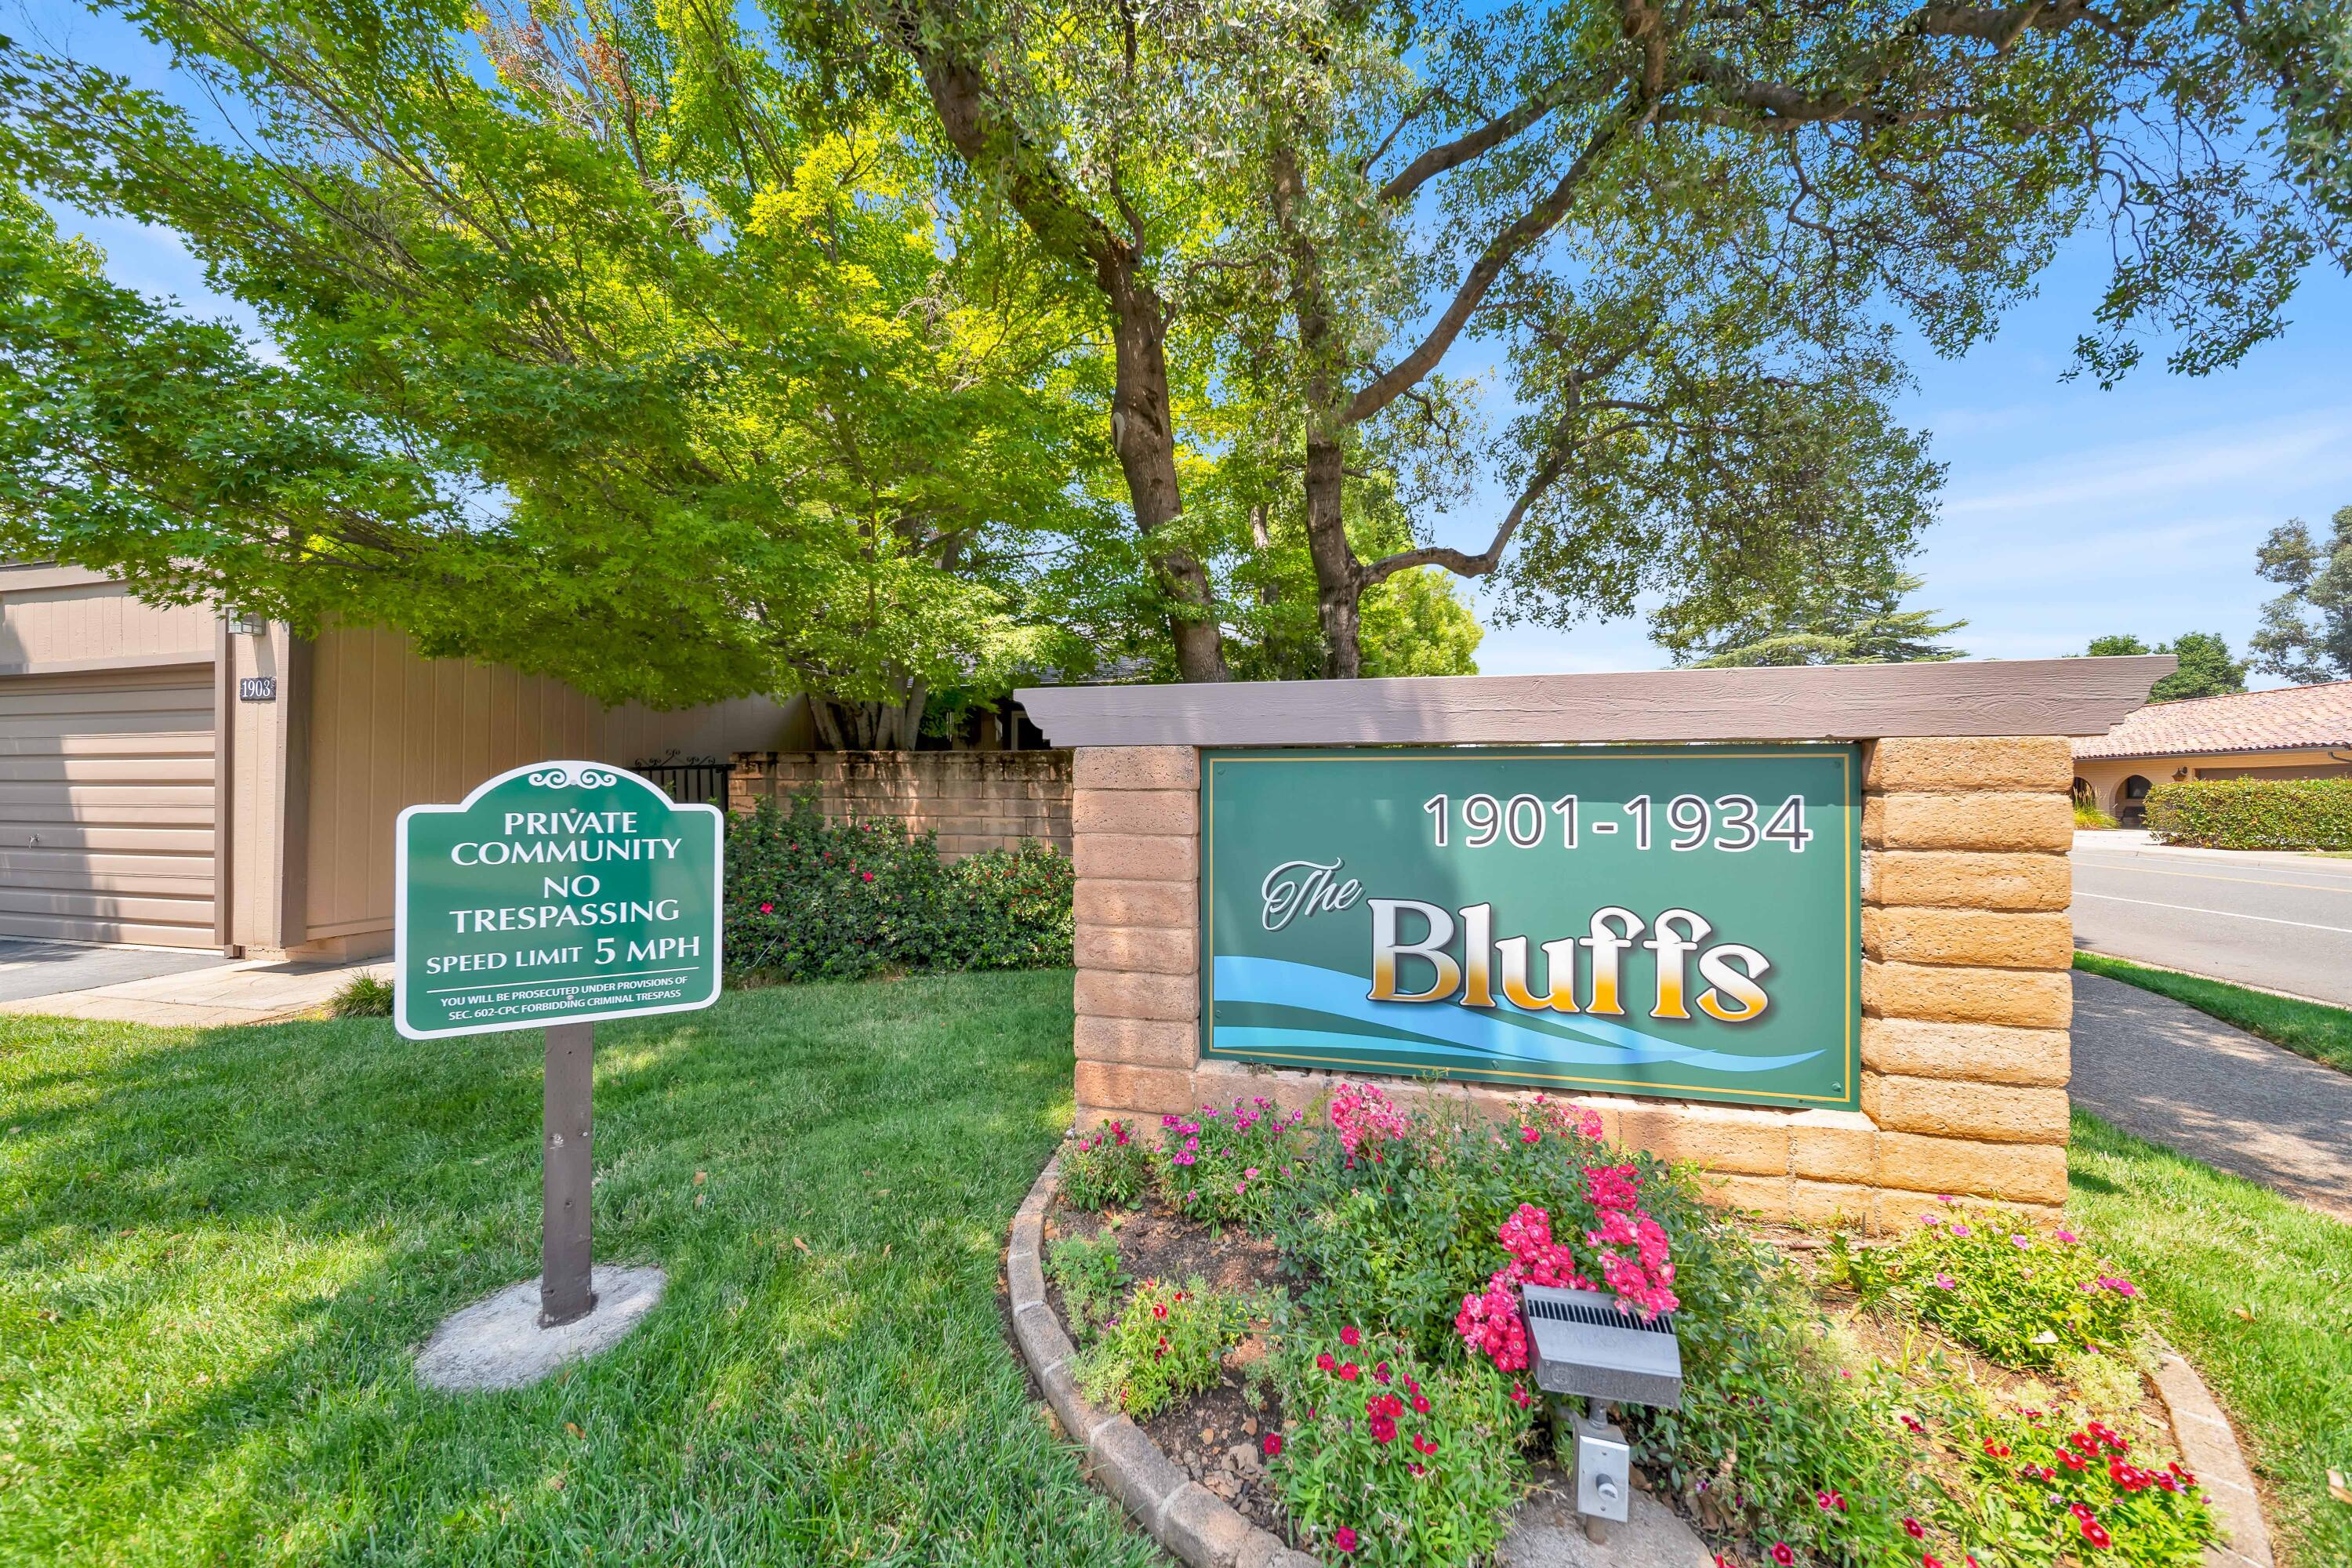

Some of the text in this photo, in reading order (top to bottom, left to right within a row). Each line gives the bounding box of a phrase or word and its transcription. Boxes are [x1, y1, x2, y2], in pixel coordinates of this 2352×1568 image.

[241, 680, 270, 697] 1903
[504, 811, 637, 836] PRIVATE
[1424, 793, 1813, 852] 1901-1934
[451, 838, 682, 866] COMMUNITY
[543, 875, 601, 898] NO
[449, 899, 680, 934] TRESPASSING
[426, 936, 700, 975] SPEED LIMIT 5 MPH
[1261, 857, 1772, 1023] The Bluffs
[441, 975, 688, 1007] YOU WILL BE PROSECUTED UNDER PROVISIONS OF
[448, 989, 681, 1021] SEC. 602-CPC FORBIDDING CRIMINAL TRESPASS
